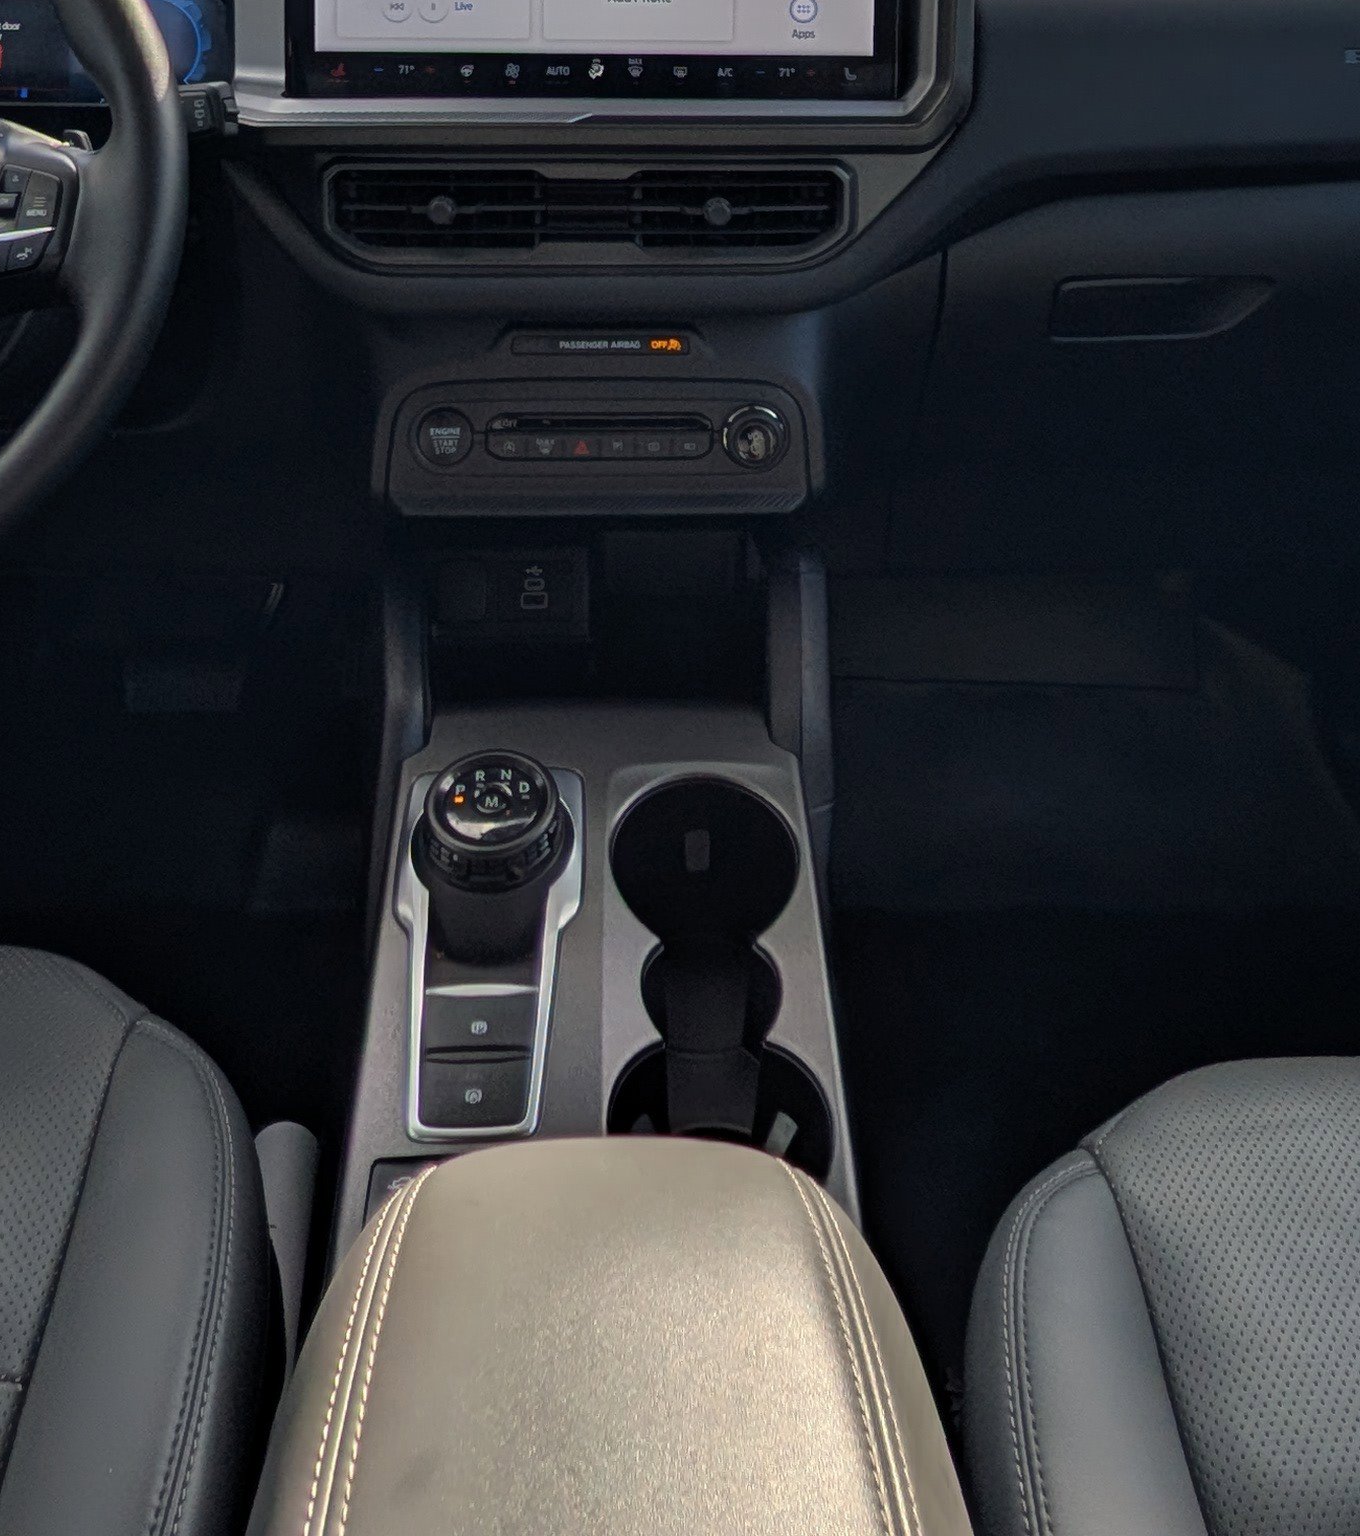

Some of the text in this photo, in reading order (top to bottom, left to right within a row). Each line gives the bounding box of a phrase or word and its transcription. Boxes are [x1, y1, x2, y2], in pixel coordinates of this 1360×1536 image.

[454, 2, 473, 11] Live
[2, 22, 21, 31] door
[791, 29, 815, 40] Apps
[546, 65, 570, 77] AUTO
[717, 67, 733, 78] A/C
[26, 209, 47, 217] MENU
[559, 340, 668, 349] PASSENGER AIRBAG OFF
[430, 427, 461, 436] ENGINE
[435, 447, 457, 455] STOP
[475, 769, 485, 781] R
[501, 769, 512, 780] N
[455, 784, 466, 795] P
[519, 781, 530, 793] D
[485, 796, 499, 808] M
